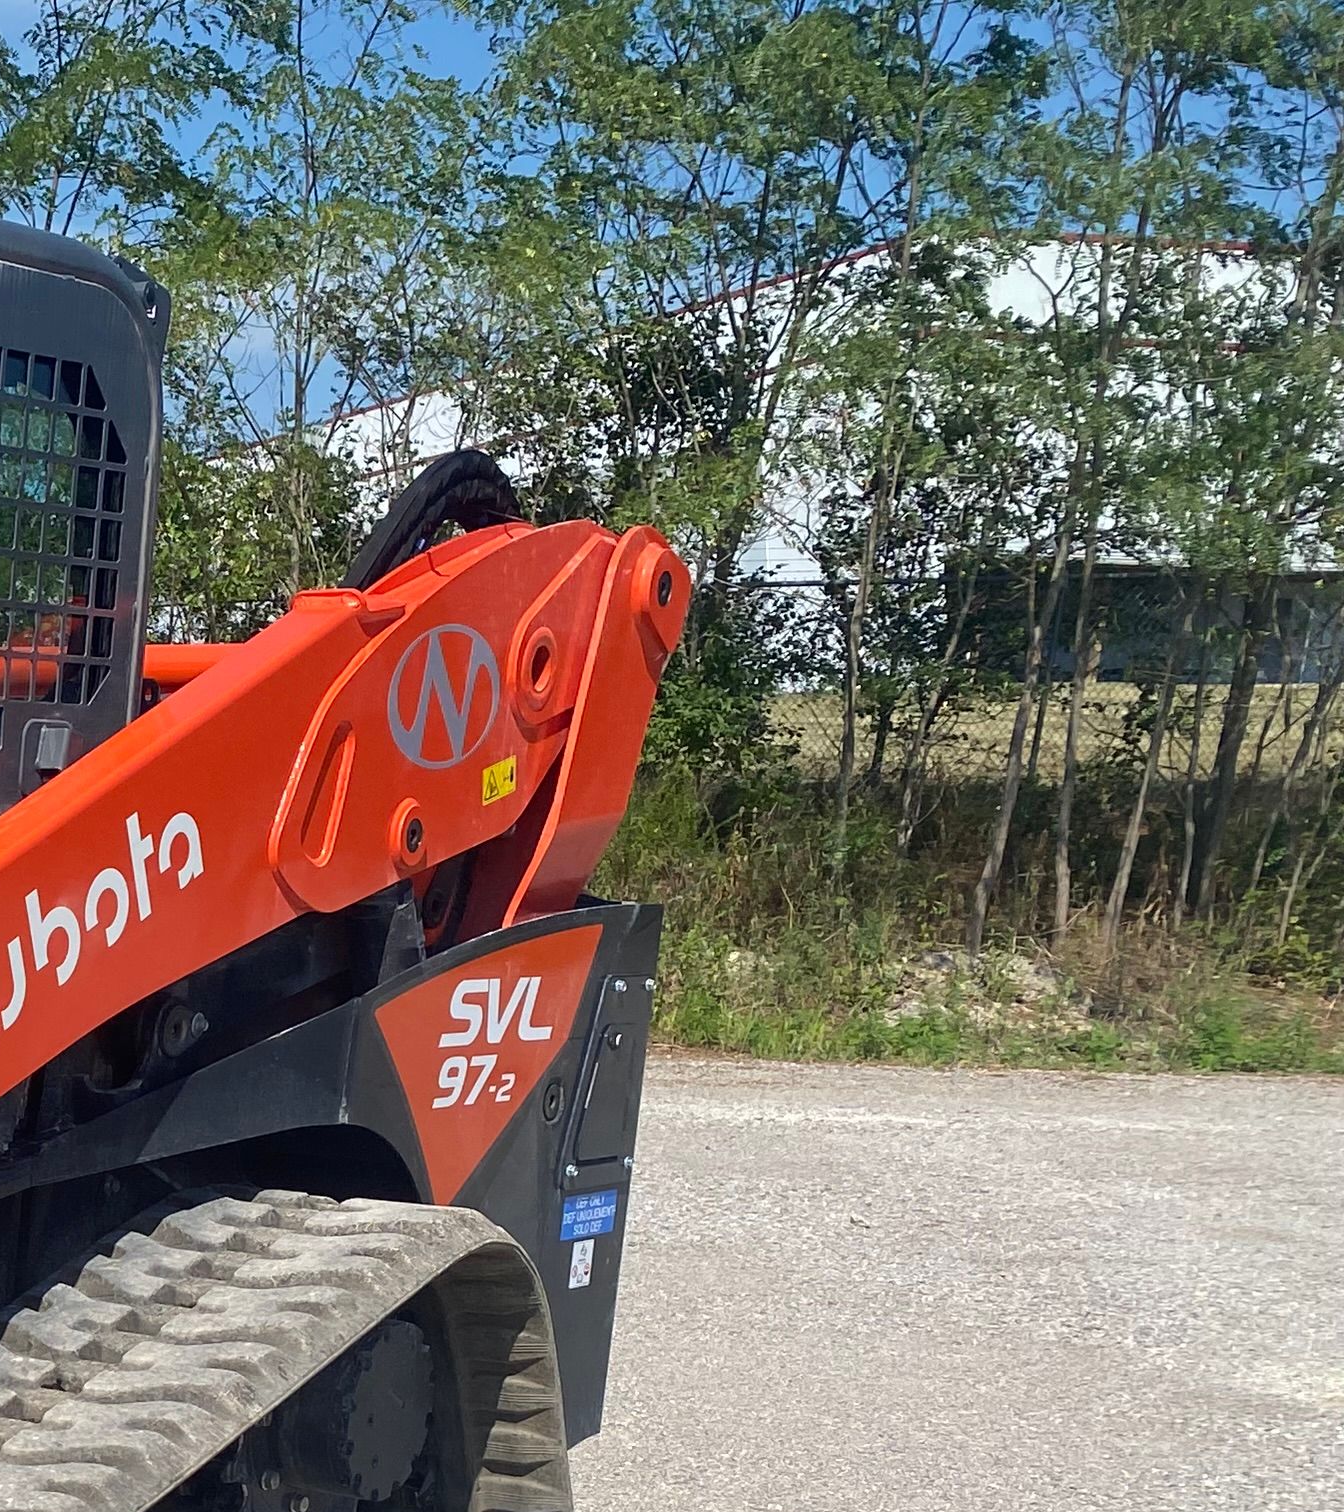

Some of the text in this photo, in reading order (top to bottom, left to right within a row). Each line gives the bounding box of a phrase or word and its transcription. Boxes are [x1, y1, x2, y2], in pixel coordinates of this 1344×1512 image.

[438, 976, 553, 1048] SVL
[432, 1054, 516, 1109] 97-2
[563, 1211, 576, 1225] DEF
[590, 1219, 602, 1232] DEF
